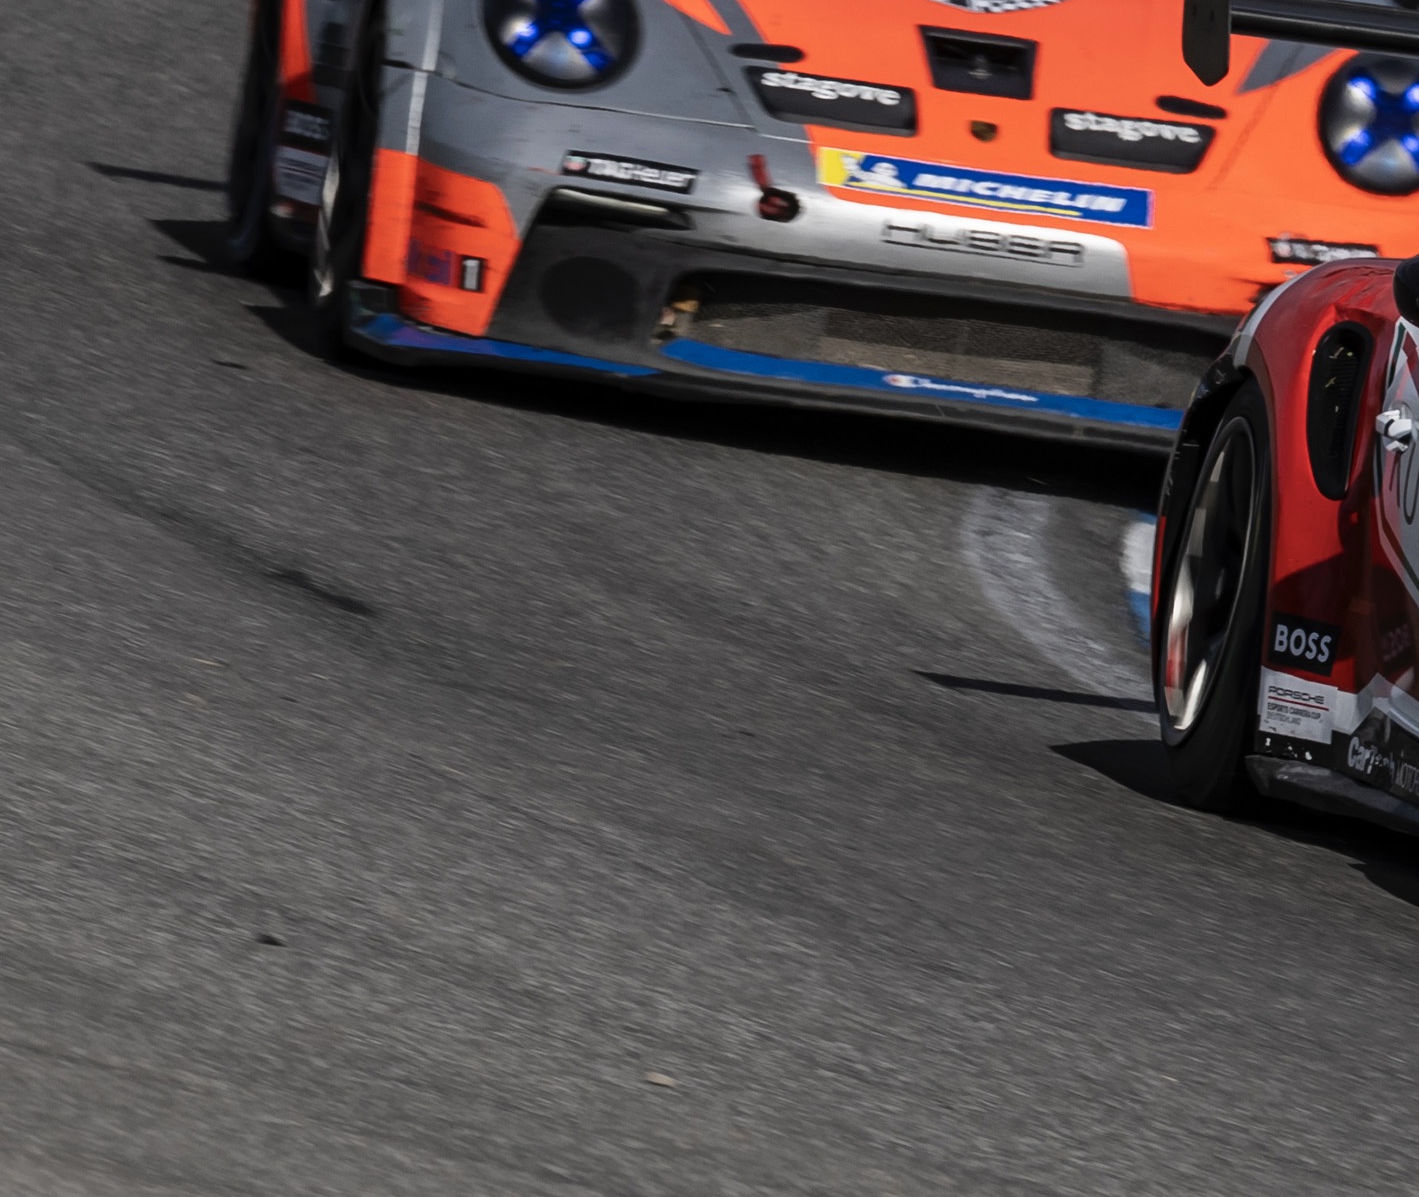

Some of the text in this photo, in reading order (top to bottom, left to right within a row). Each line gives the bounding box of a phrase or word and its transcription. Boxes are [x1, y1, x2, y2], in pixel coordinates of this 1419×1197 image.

[911, 172, 1128, 213] MICHELIN
[881, 219, 1086, 265] HUBER
[1274, 624, 1333, 663] BOSS
